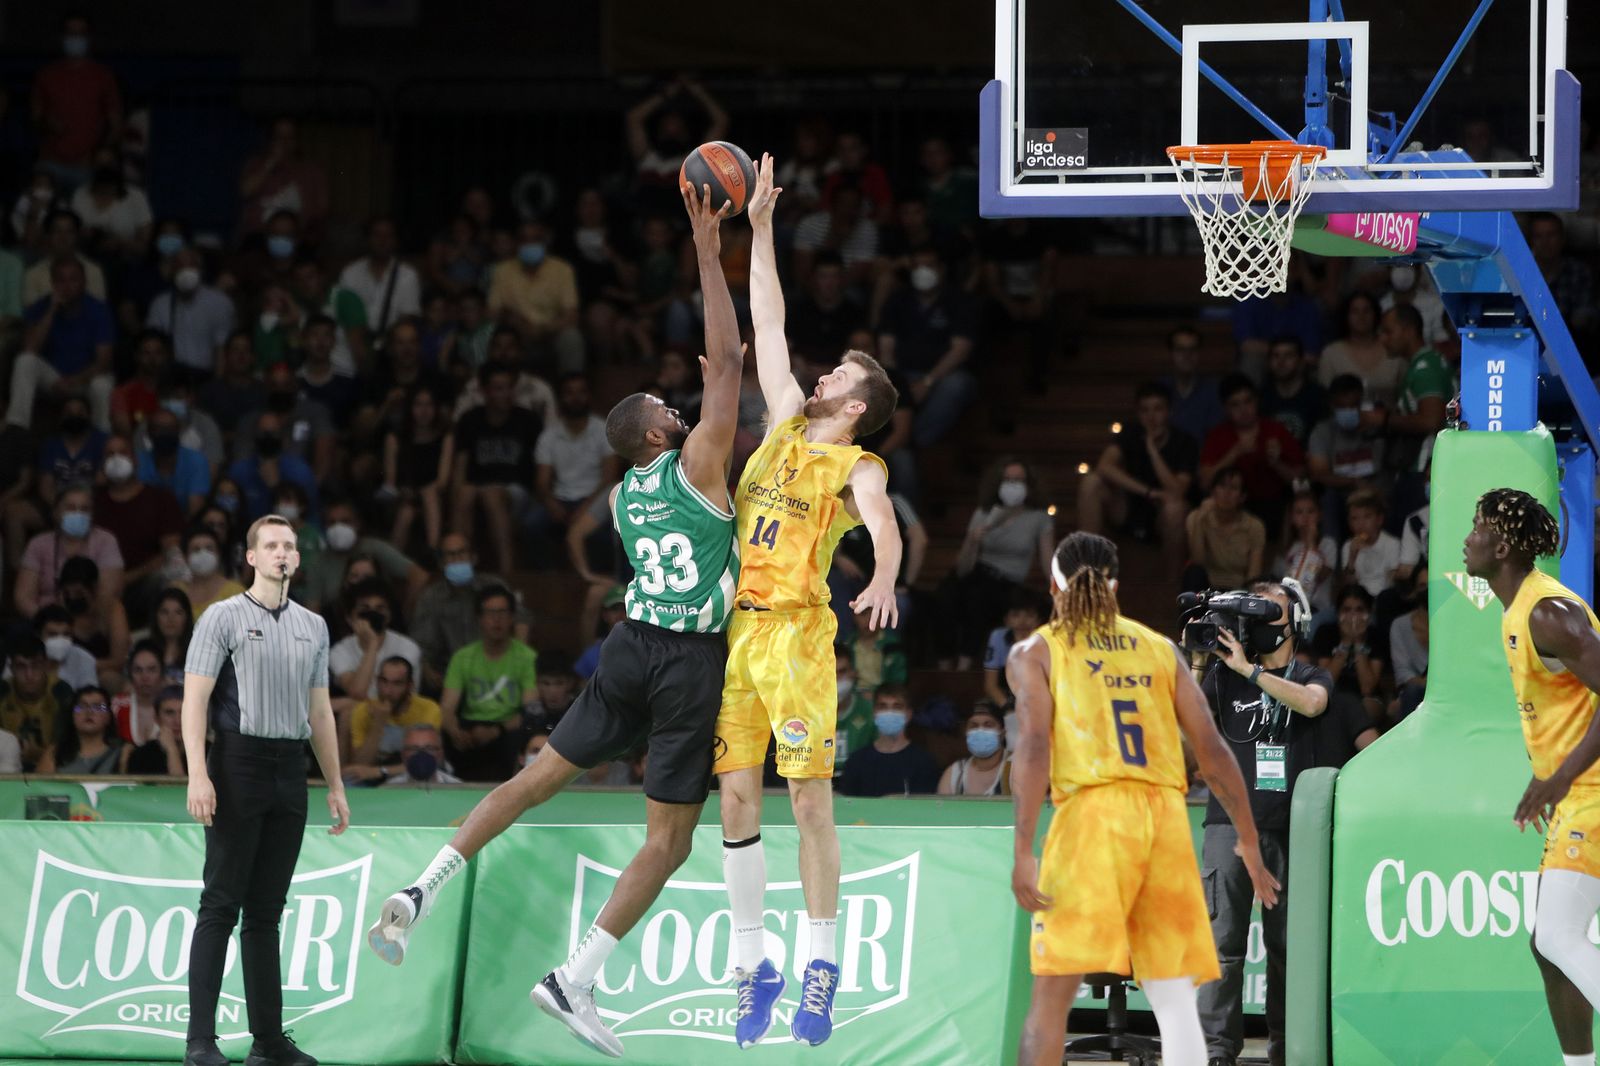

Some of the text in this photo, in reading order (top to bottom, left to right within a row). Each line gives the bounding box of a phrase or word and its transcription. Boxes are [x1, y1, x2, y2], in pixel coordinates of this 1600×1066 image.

[1026, 140, 1053, 155] liga
[1026, 153, 1085, 167] endesa
[1487, 360, 1505, 432] MONDO
[749, 515, 780, 550] 14
[635, 533, 699, 595] 33
[1111, 699, 1147, 768] 6
[778, 743, 813, 754] Poema
[779, 754, 792, 762] del
[1365, 858, 1538, 947] COOS
[41, 888, 340, 991] COOR
[117, 1003, 240, 1023] ORIGN
[668, 1007, 793, 1027] ORIN
